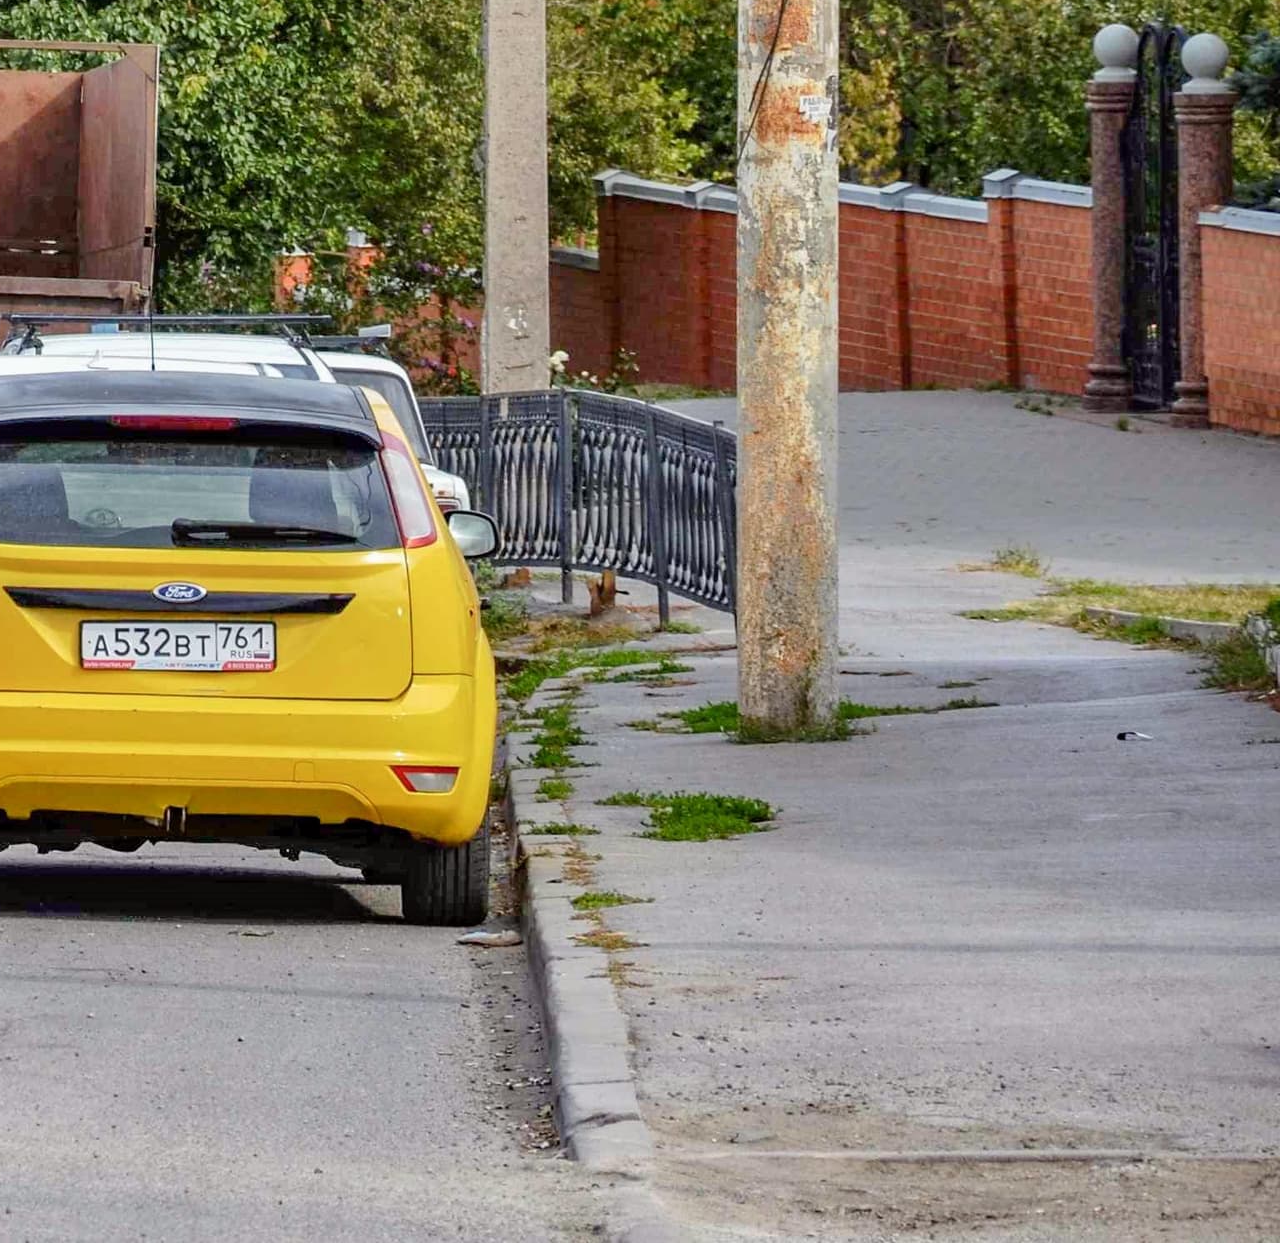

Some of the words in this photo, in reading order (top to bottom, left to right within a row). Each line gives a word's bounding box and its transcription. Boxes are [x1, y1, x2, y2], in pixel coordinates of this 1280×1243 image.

[165, 586, 194, 598] Ford
[219, 627, 265, 649] 761
[230, 650, 253, 659] RUS
